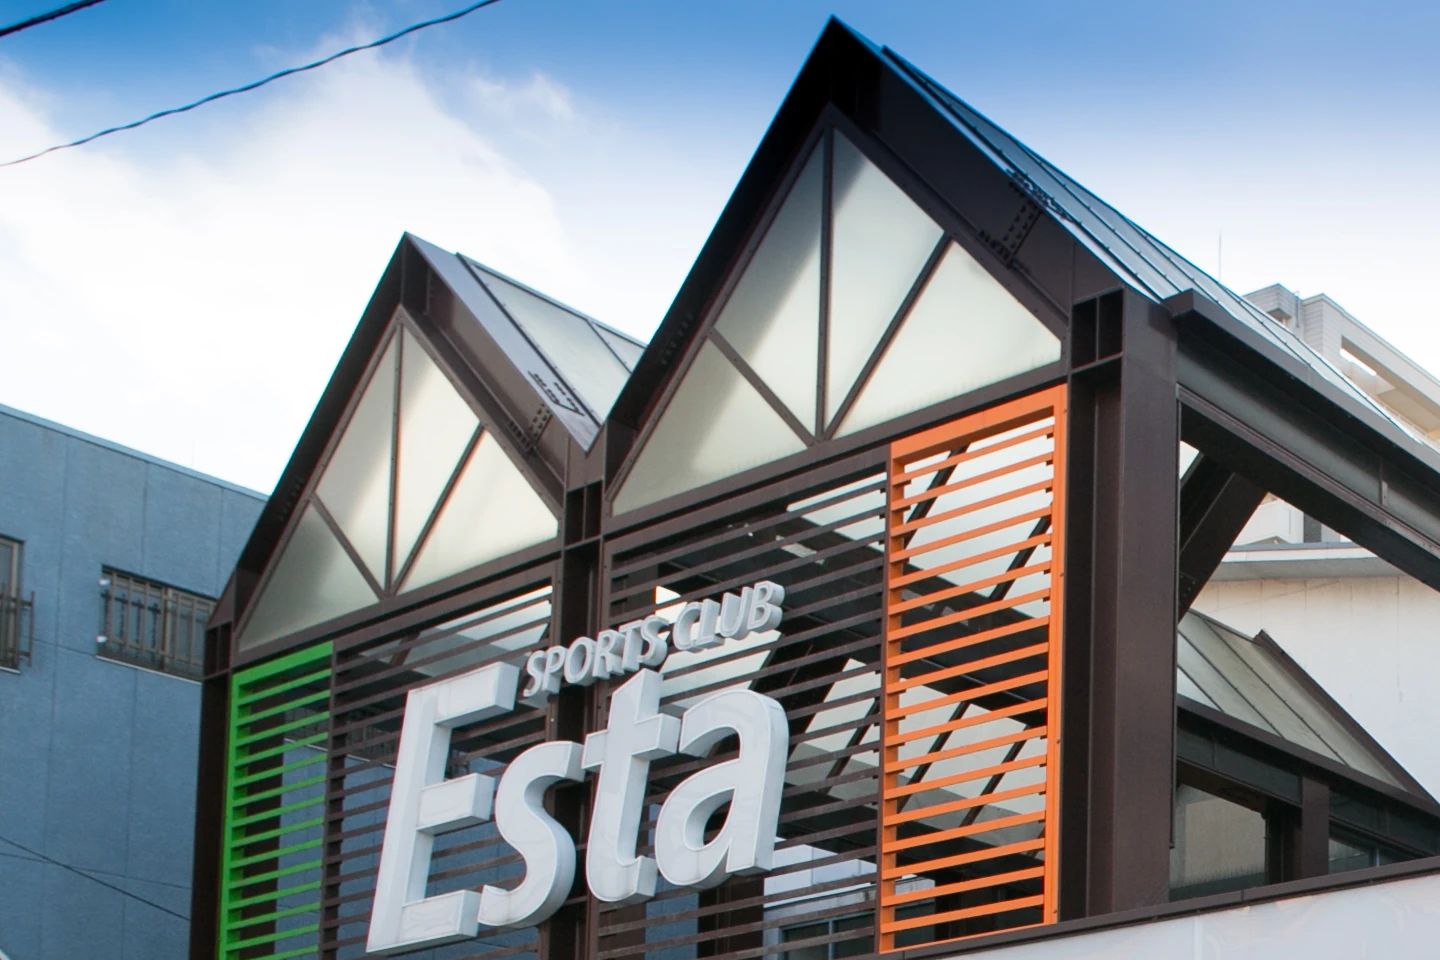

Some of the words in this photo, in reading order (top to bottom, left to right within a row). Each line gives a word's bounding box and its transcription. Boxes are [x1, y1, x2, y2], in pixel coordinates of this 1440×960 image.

[523, 614, 668, 699] SPORTS
[673, 580, 786, 653] CLUB
[366, 661, 789, 953] Esta
